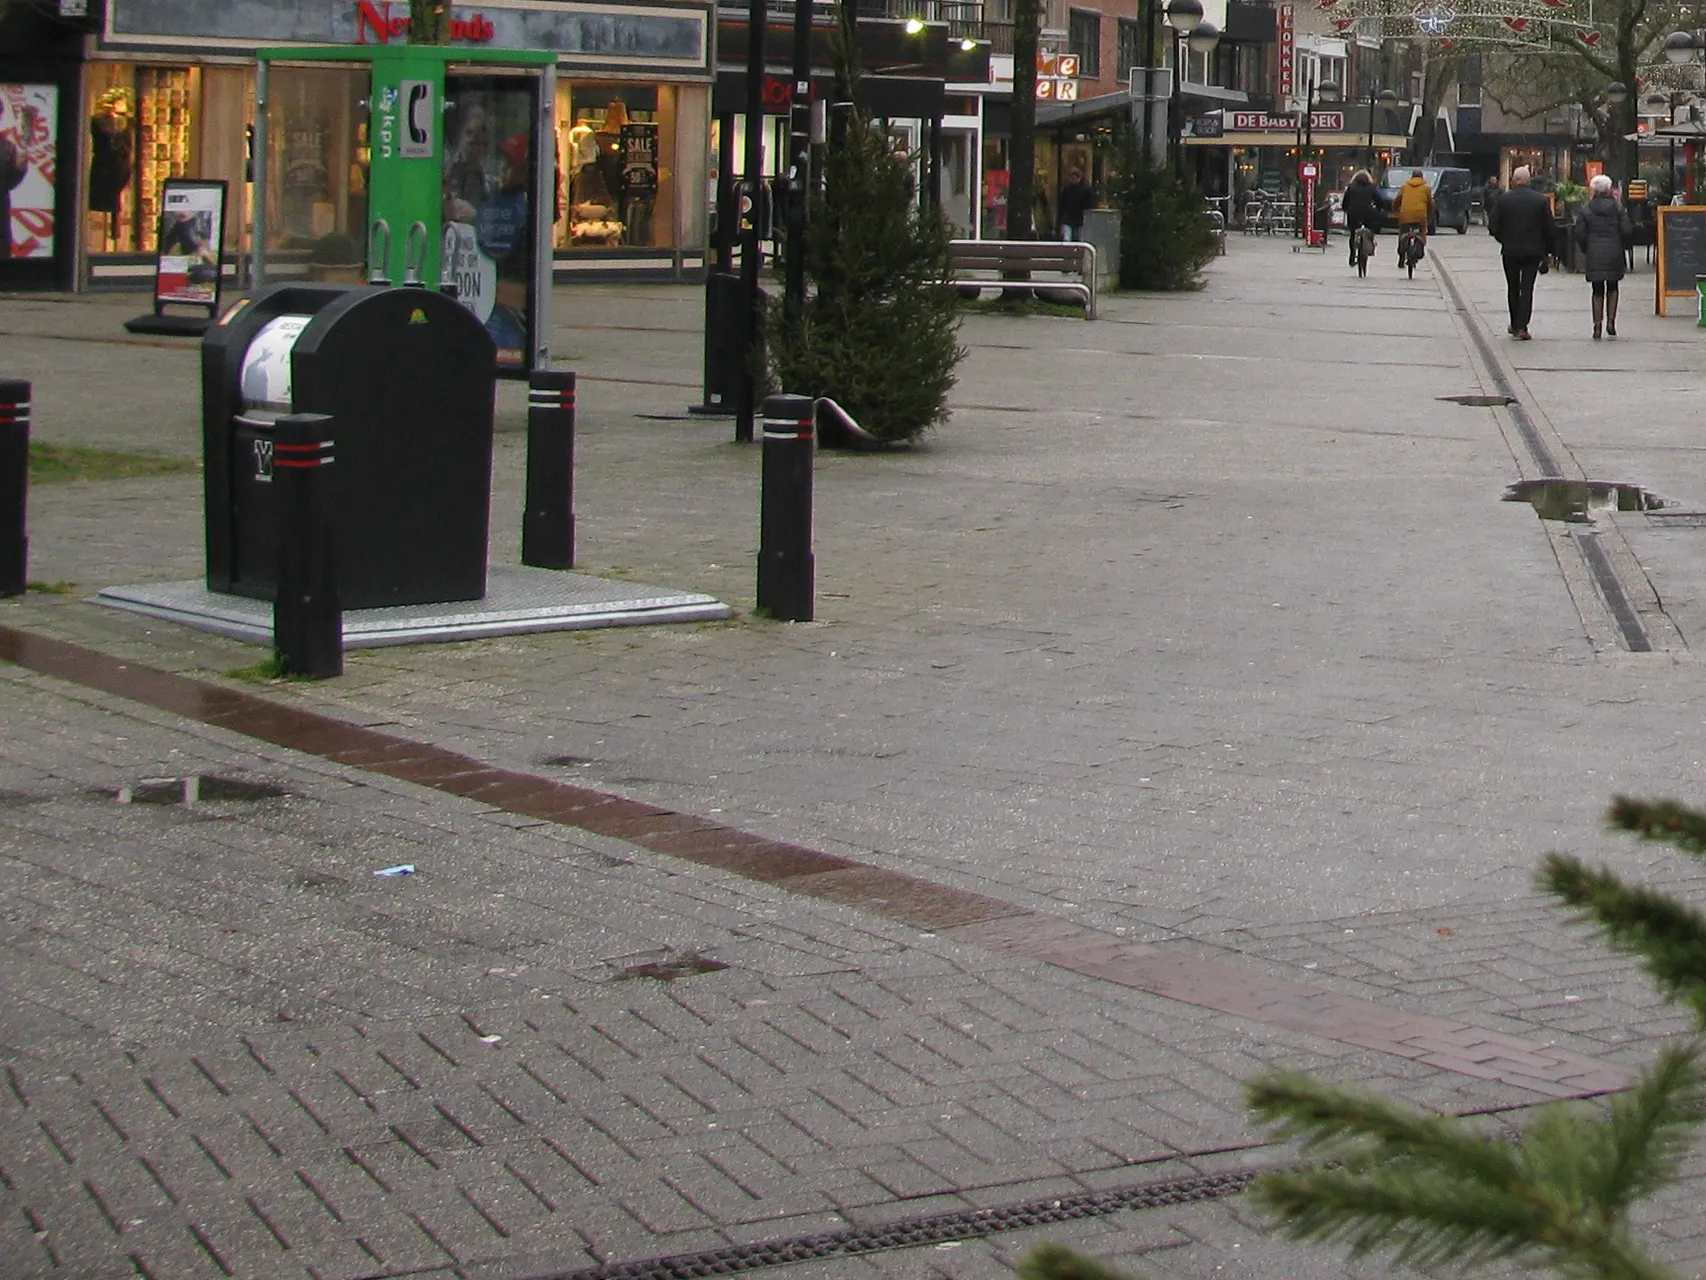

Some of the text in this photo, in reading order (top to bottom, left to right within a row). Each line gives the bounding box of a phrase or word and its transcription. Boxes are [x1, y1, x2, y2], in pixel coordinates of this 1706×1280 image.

[1282, 5, 1292, 95] BLOKKER
[1237, 114, 1257, 128] DE
[627, 137, 653, 153] SALE
